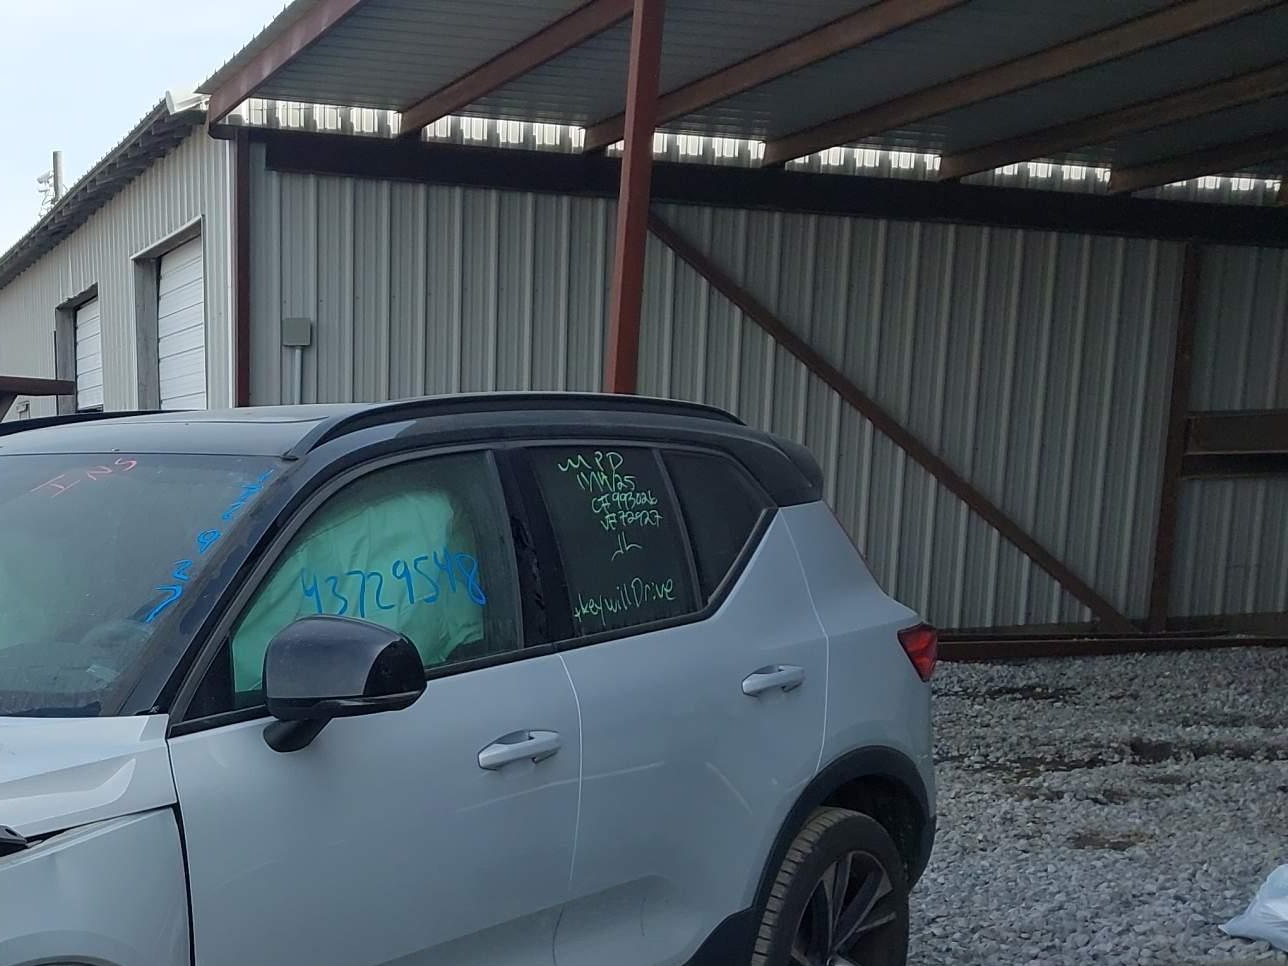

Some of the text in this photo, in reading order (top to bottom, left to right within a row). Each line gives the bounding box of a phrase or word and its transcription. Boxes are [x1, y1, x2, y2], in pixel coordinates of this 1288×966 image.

[30, 457, 138, 499] INS
[557, 450, 623, 472] MPD
[301, 546, 487, 618] 43729548
